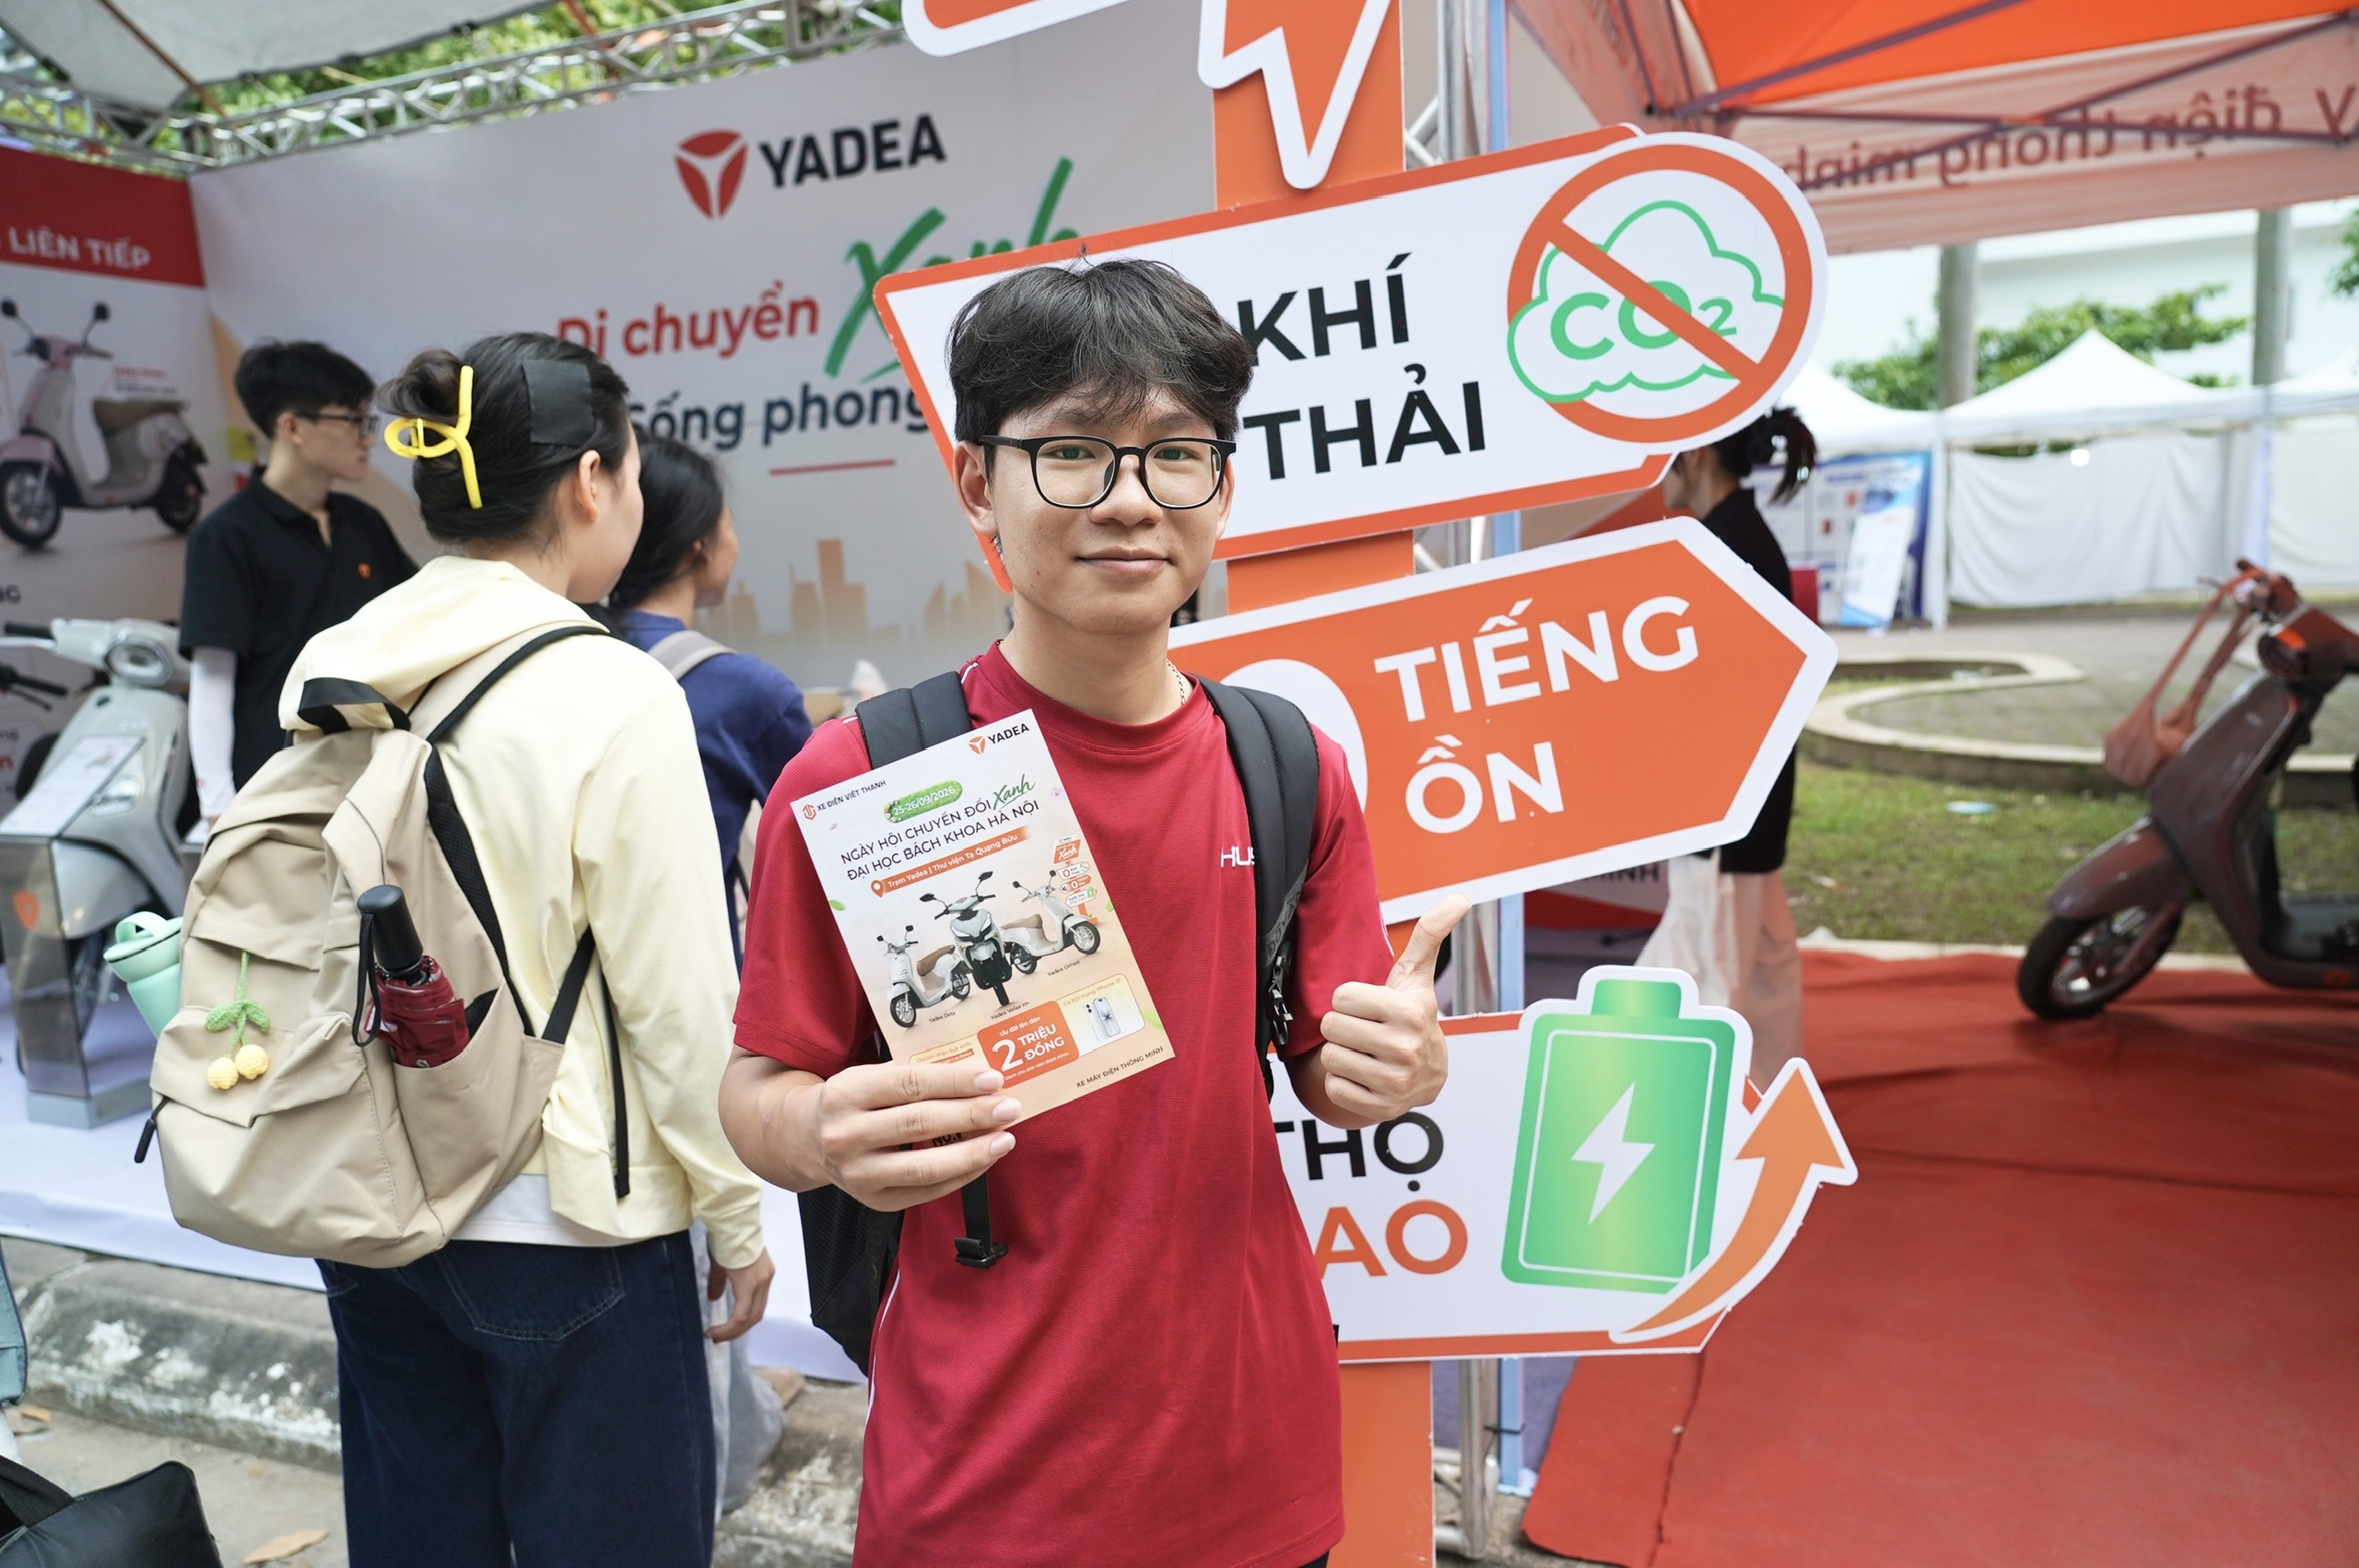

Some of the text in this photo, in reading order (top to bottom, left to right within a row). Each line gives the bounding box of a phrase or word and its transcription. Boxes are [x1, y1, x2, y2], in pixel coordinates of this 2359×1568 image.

[757, 114, 947, 190] YADEA
[7, 226, 151, 270] LIÊN TIẾP
[824, 156, 1079, 379] Xh
[623, 281, 819, 360] chuyển
[1238, 252, 1412, 367] KHÍ
[763, 382, 929, 445] phong
[1242, 363, 1485, 480] THẢI
[1374, 595, 1699, 722] TIẾNG
[987, 723, 1030, 744] YADEA
[817, 802, 826, 811] XE
[861, 780, 886, 793] THANH
[892, 786, 956, 815] 25-26/09/2026
[1405, 734, 1564, 834] ỒN
[840, 774, 1037, 864] NGÀY HỘI CHUYỂN ĐỔI Xanh
[847, 800, 1039, 881] ĐẠI HỌC BÁCH KHOA HÀ NỘI
[887, 877, 906, 888] Trạm
[906, 870, 928, 881] Yadea
[933, 862, 948, 872] Thư
[947, 855, 965, 867] viện
[965, 851, 975, 860] Tạ
[974, 841, 1001, 856] Quang
[992, 1038, 1024, 1071] 2
[1017, 1024, 1056, 1047] TRIỆU
[1024, 1036, 1065, 1061] ĐỒNG
[1076, 1080, 1086, 1088] XE
[1086, 1072, 1101, 1083] MÁY
